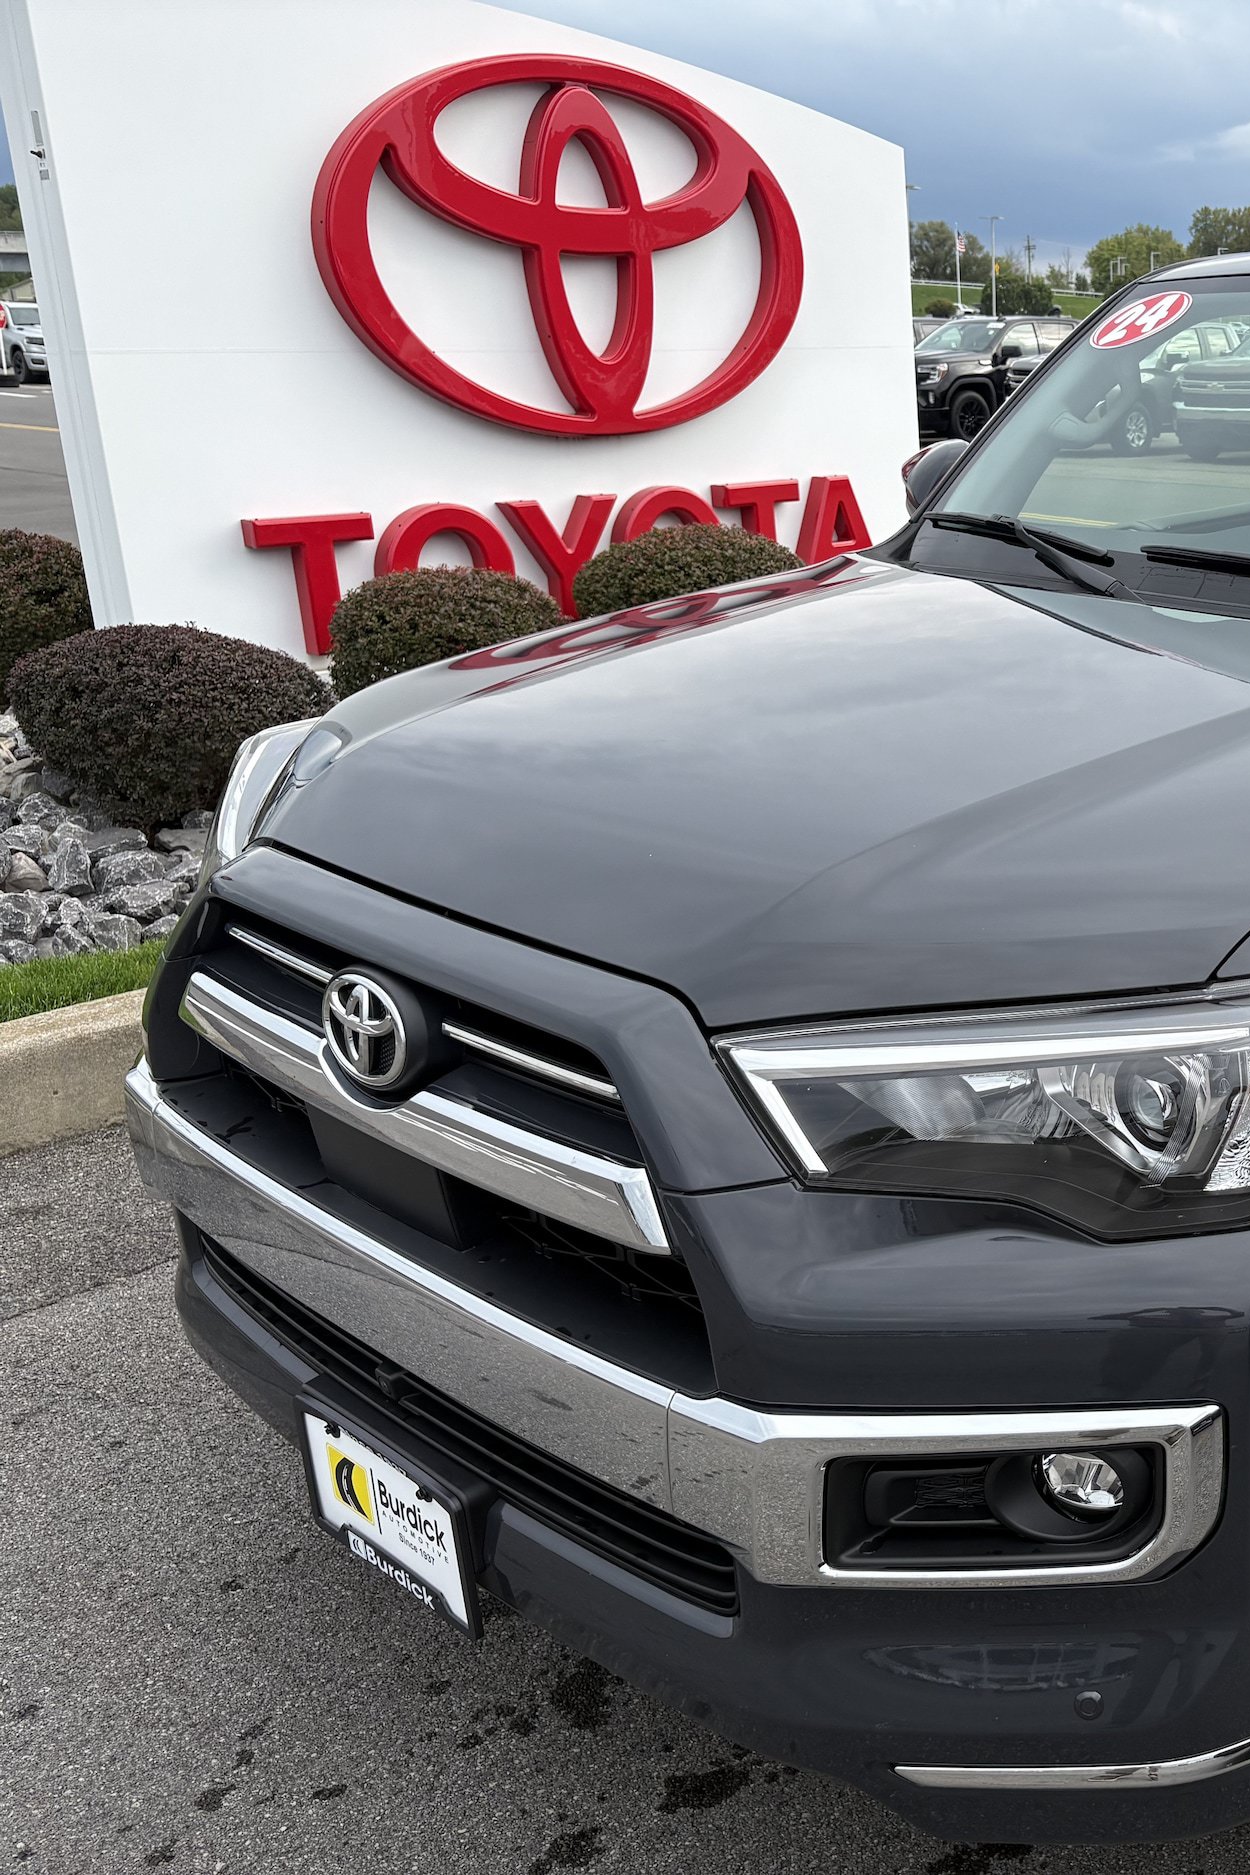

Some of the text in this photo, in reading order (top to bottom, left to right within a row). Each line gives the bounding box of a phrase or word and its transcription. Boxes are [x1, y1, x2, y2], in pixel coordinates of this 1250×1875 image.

[1098, 294, 1181, 346] 24
[377, 1479, 447, 1553] Burdick
[382, 1510, 449, 1564] AUTOMOTIVE
[398, 1532, 435, 1566] Since 1937
[365, 1543, 436, 1611] Burdick
